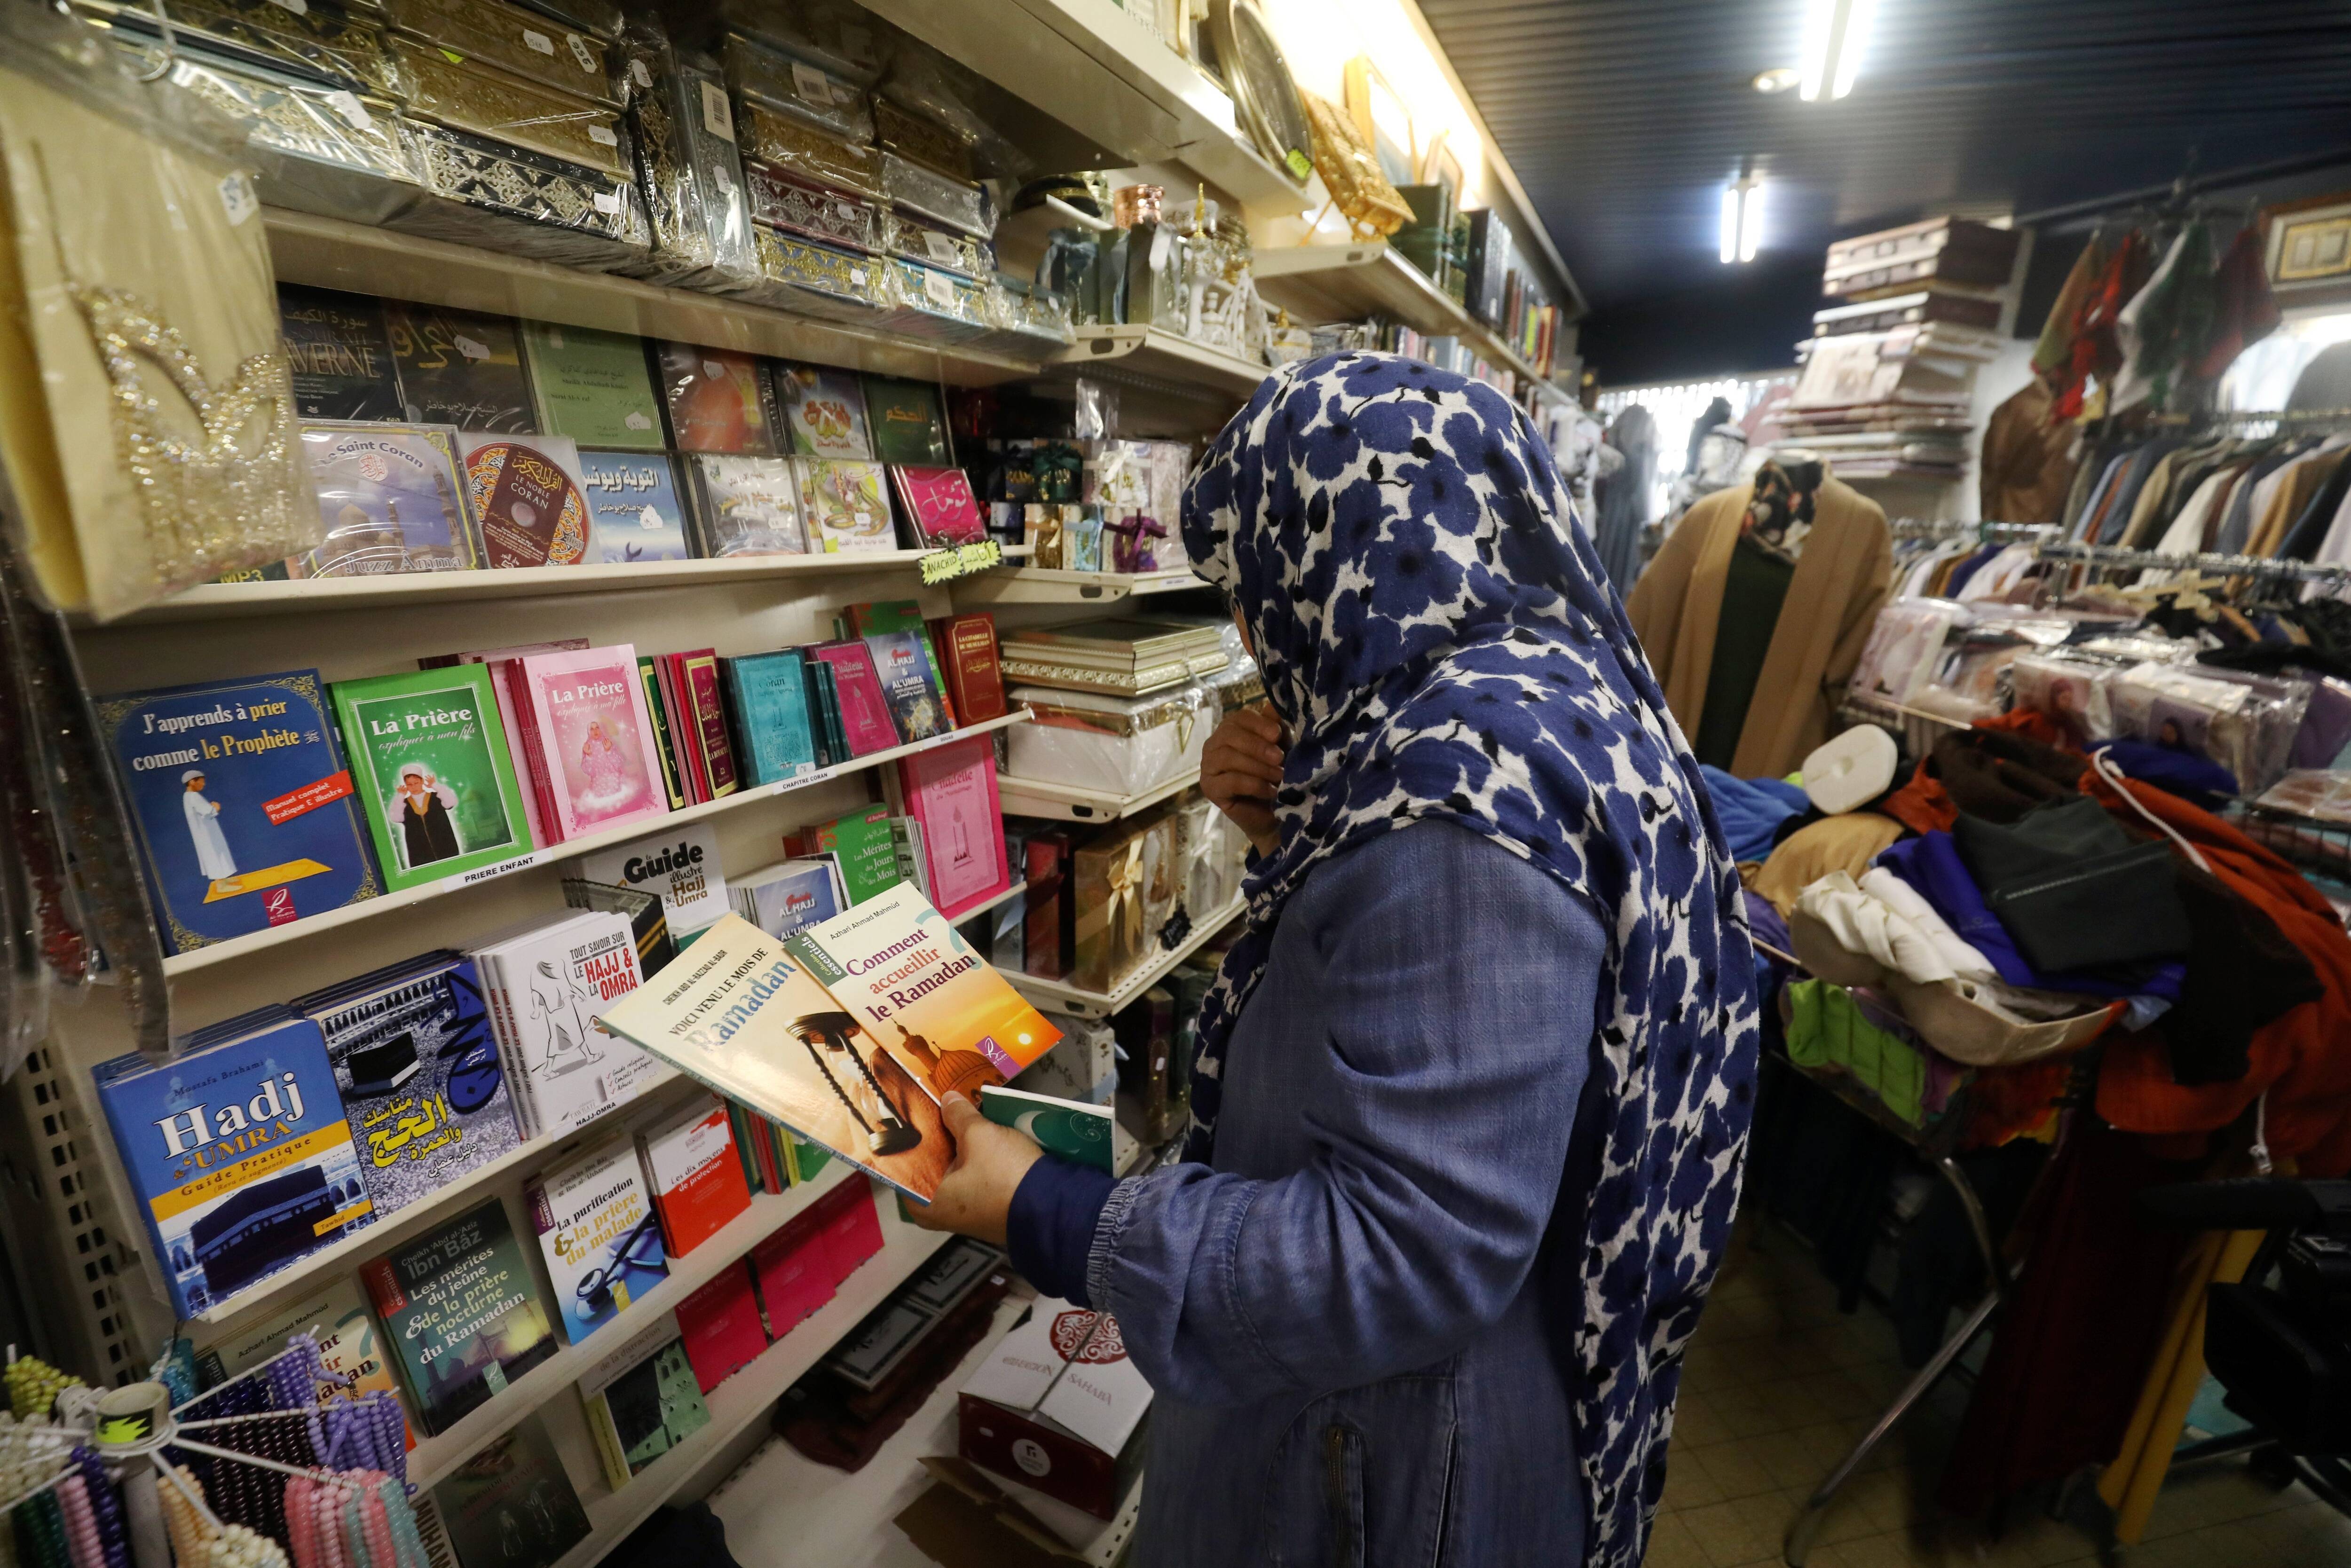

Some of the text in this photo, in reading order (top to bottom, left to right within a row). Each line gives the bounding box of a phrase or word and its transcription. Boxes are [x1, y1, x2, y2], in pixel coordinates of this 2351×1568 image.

[336, 440, 375, 455] Saint
[379, 441, 424, 469] Coran
[511, 482, 549, 510] CORAN
[515, 474, 551, 499] LE NOBLE
[344, 555, 393, 574] Juzz
[926, 555, 957, 575] ANACHID
[887, 655, 915, 668] AL HAJJ
[901, 668, 908, 676] &
[553, 680, 624, 704] La Prière
[612, 696, 627, 712] fille
[142, 699, 287, 734] J'apprends à prier
[371, 709, 472, 736] La Prière
[132, 747, 199, 772] comme
[204, 736, 219, 759] le
[224, 728, 300, 757] Prophète
[379, 722, 476, 755] expliquée à mon fils
[782, 772, 828, 790] CHAPITRE CORAN
[266, 782, 330, 812] Manuel complet
[271, 787, 343, 821] Pratique illustré
[623, 841, 703, 884] Guide
[862, 841, 892, 859] Mérites
[873, 855, 894, 871] Jours
[465, 856, 534, 883] PRIERE ENFANT
[670, 863, 703, 883] illustré
[876, 867, 896, 882] Mois
[672, 875, 706, 897] Hajj
[779, 898, 816, 917] AL HAJJ
[796, 914, 803, 924] &
[851, 914, 874, 930] Ahmad
[873, 901, 901, 919] Mahmûd
[569, 930, 626, 959] TOUT SAVOIR SUR
[801, 936, 843, 976] essentiels
[846, 926, 929, 977] Comment
[573, 947, 633, 984] LE HAJJ &
[662, 988, 682, 1006] CHEIKH
[678, 982, 691, 993] ABD
[707, 949, 728, 967] AL-BADR
[808, 952, 833, 977] Collection
[869, 946, 941, 994] accueillir
[588, 969, 639, 1001] LA OMRA
[668, 947, 769, 1036] VOICI VENU LE MOIS DE
[865, 953, 977, 1023] le Ramadan
[683, 961, 797, 1053] Ramadan
[174, 1060, 264, 1098] Mostafa Brahami
[612, 1055, 645, 1076] Guide religieux
[614, 1058, 653, 1084] Conseils pratiques
[617, 1079, 633, 1091] Astuces
[154, 1071, 305, 1160] Hadj
[363, 1095, 414, 1128] مناسك
[576, 1102, 616, 1127] HAJJ-OMRA
[367, 1092, 448, 1168] الحج
[410, 1125, 463, 1160] والعمرة
[457, 1141, 479, 1162] دليل
[173, 1169, 185, 1180] &
[181, 1137, 311, 1197] Guide Pratique
[584, 1164, 595, 1173] Ibn
[670, 1174, 684, 1185] Les
[685, 1164, 697, 1176] dix
[678, 1183, 688, 1193] de
[689, 1159, 723, 1187] protection
[565, 1183, 576, 1193] Ibn
[881, 1176, 897, 1189] VOICI
[536, 1190, 553, 1227] essentiels
[556, 1177, 633, 1232] La purification
[320, 1214, 345, 1230] Tawhid
[553, 1192, 638, 1257] & la prière
[566, 1207, 643, 1267] du malade
[402, 1248, 429, 1267] Cheikh
[407, 1230, 483, 1280] Ibn Bâz
[384, 1266, 403, 1306] essentiels
[410, 1247, 494, 1301] Les mérites
[427, 1266, 488, 1306] du jeûne
[421, 1311, 441, 1329] de
[442, 1299, 460, 1315] la
[464, 1269, 509, 1307] prière
[435, 1287, 504, 1335] nocturne
[266, 1322, 294, 1342] Ahmad
[295, 1303, 329, 1325] Mahmûd
[420, 1292, 526, 1365] du Ramadan
[600, 1327, 661, 1372] de la distraction
